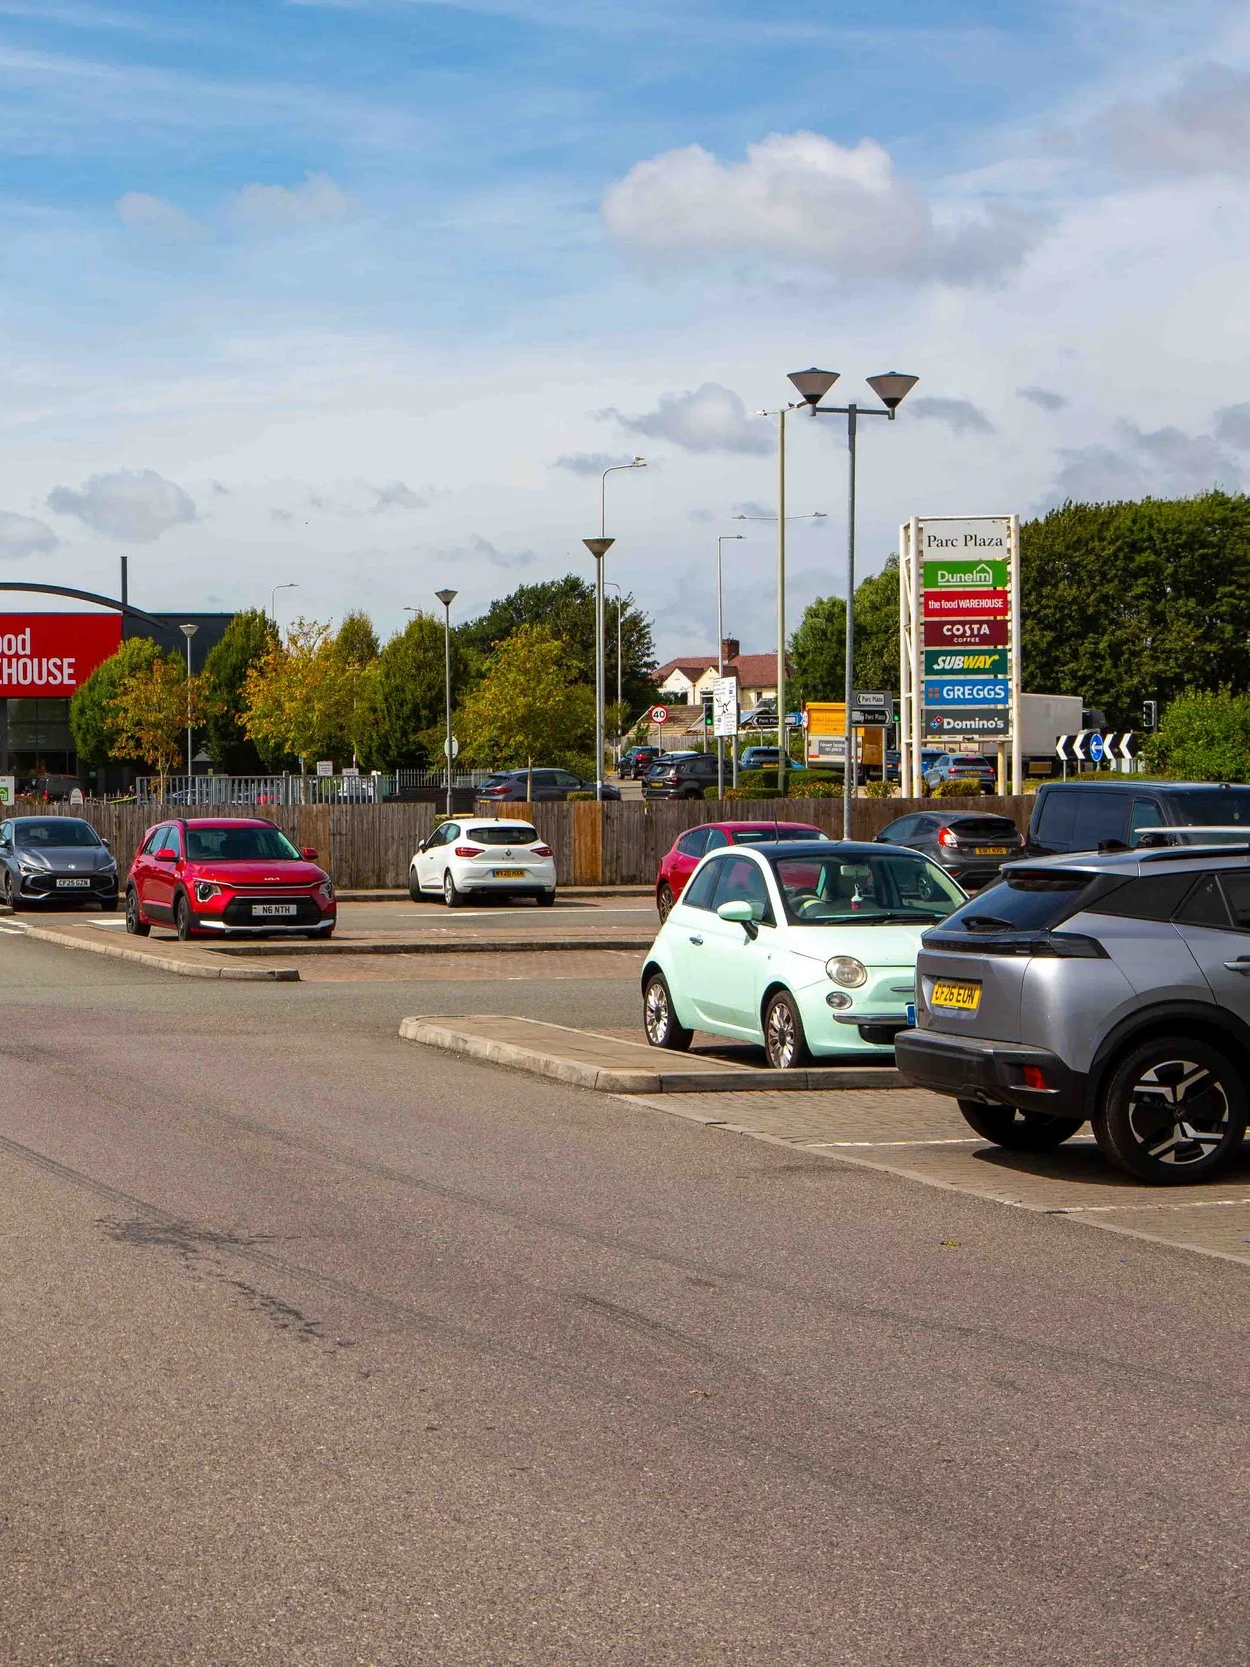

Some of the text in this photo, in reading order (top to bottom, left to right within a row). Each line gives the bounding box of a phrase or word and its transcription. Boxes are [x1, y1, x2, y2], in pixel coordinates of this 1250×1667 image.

[927, 534, 1003, 547] Parc Plaza
[937, 568, 991, 584] Dunelm
[928, 598, 1004, 609] the food WAREHOUSE
[943, 624, 990, 636] COSTA
[933, 654, 999, 670] SUBWAY
[943, 685, 1005, 699] GREGGS
[653, 710, 665, 718] 40
[943, 717, 1005, 729] Domino's
[262, 905, 290, 914] N6 NTH
